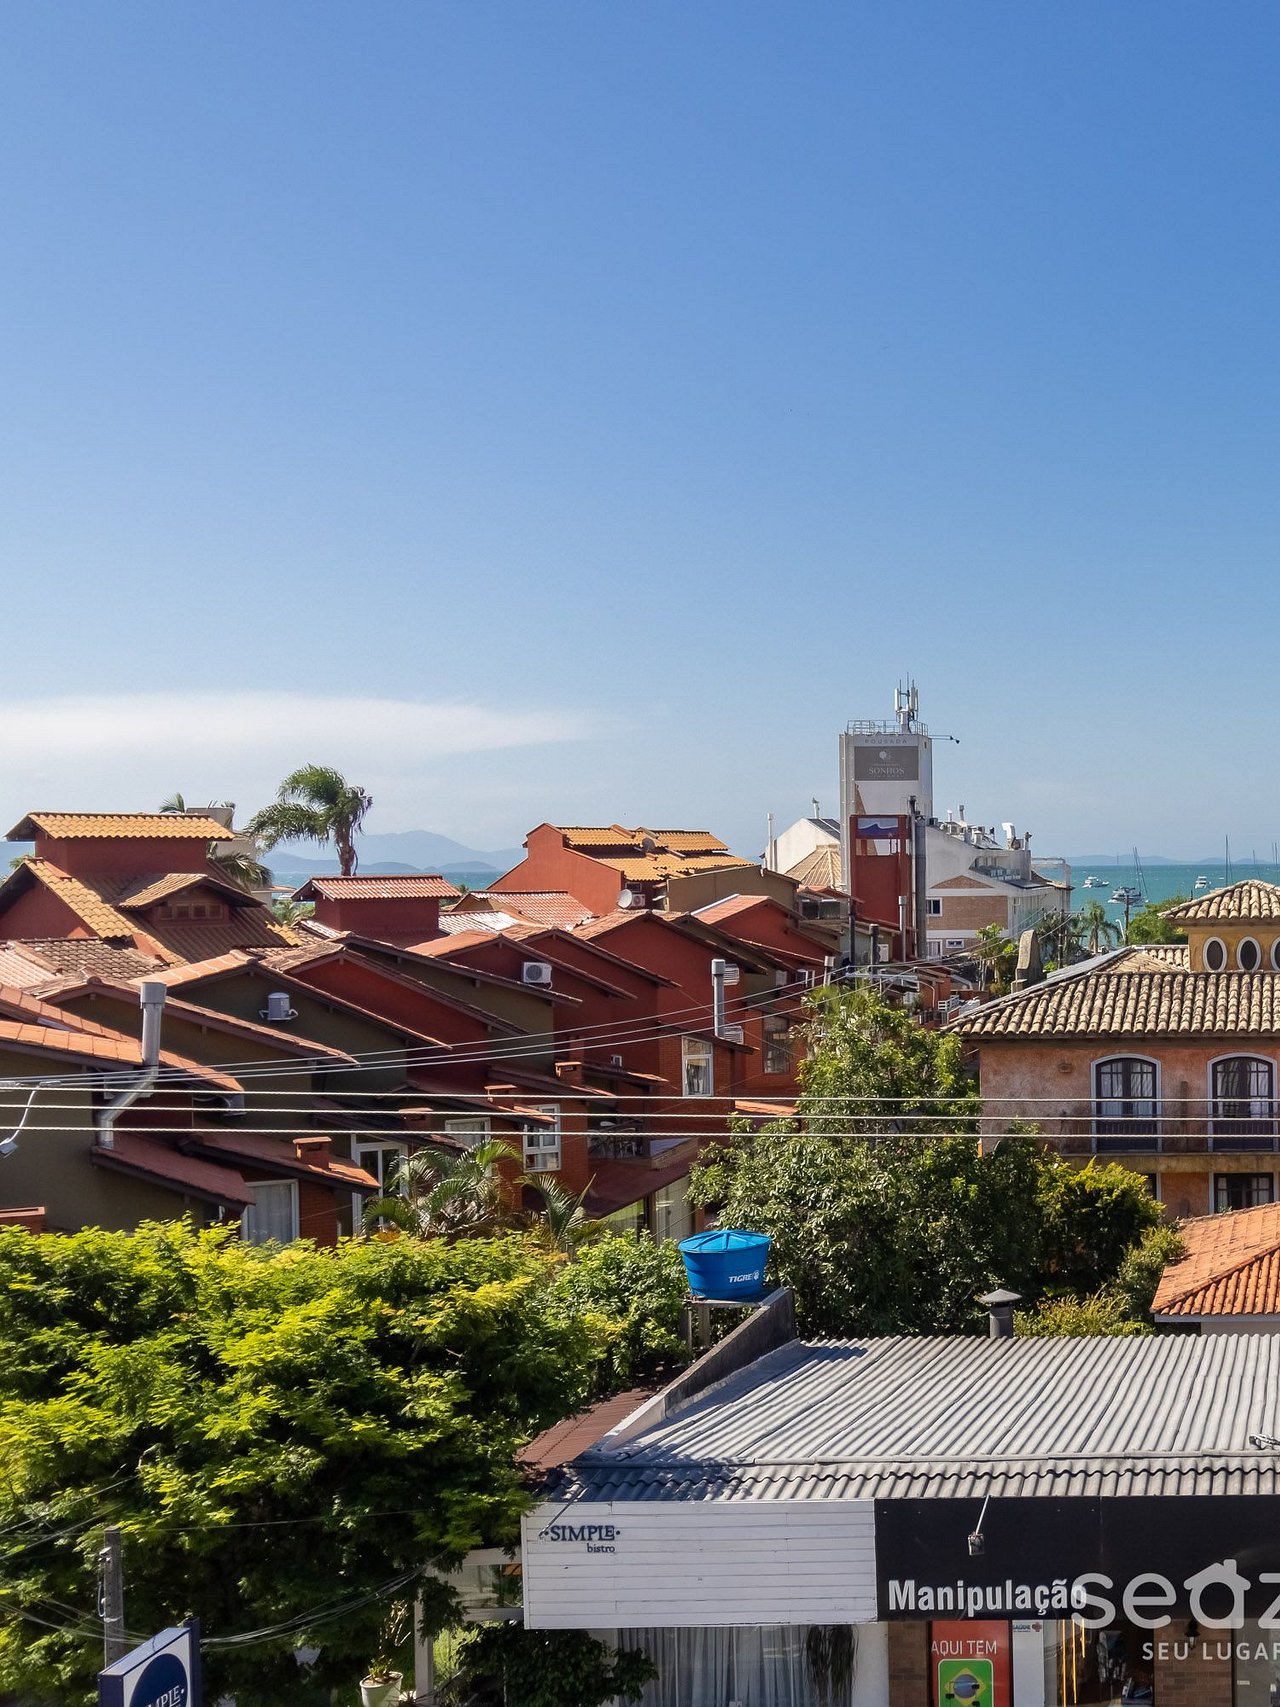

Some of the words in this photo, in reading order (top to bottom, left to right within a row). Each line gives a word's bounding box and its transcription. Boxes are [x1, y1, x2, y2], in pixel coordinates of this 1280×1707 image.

[729, 1273, 753, 1283] TIGRE
[587, 1543, 615, 1553] bistro
[888, 1578, 1087, 1617] Manipulação
[931, 1640, 963, 1657] AQUI
[966, 1640, 998, 1655] TEM
